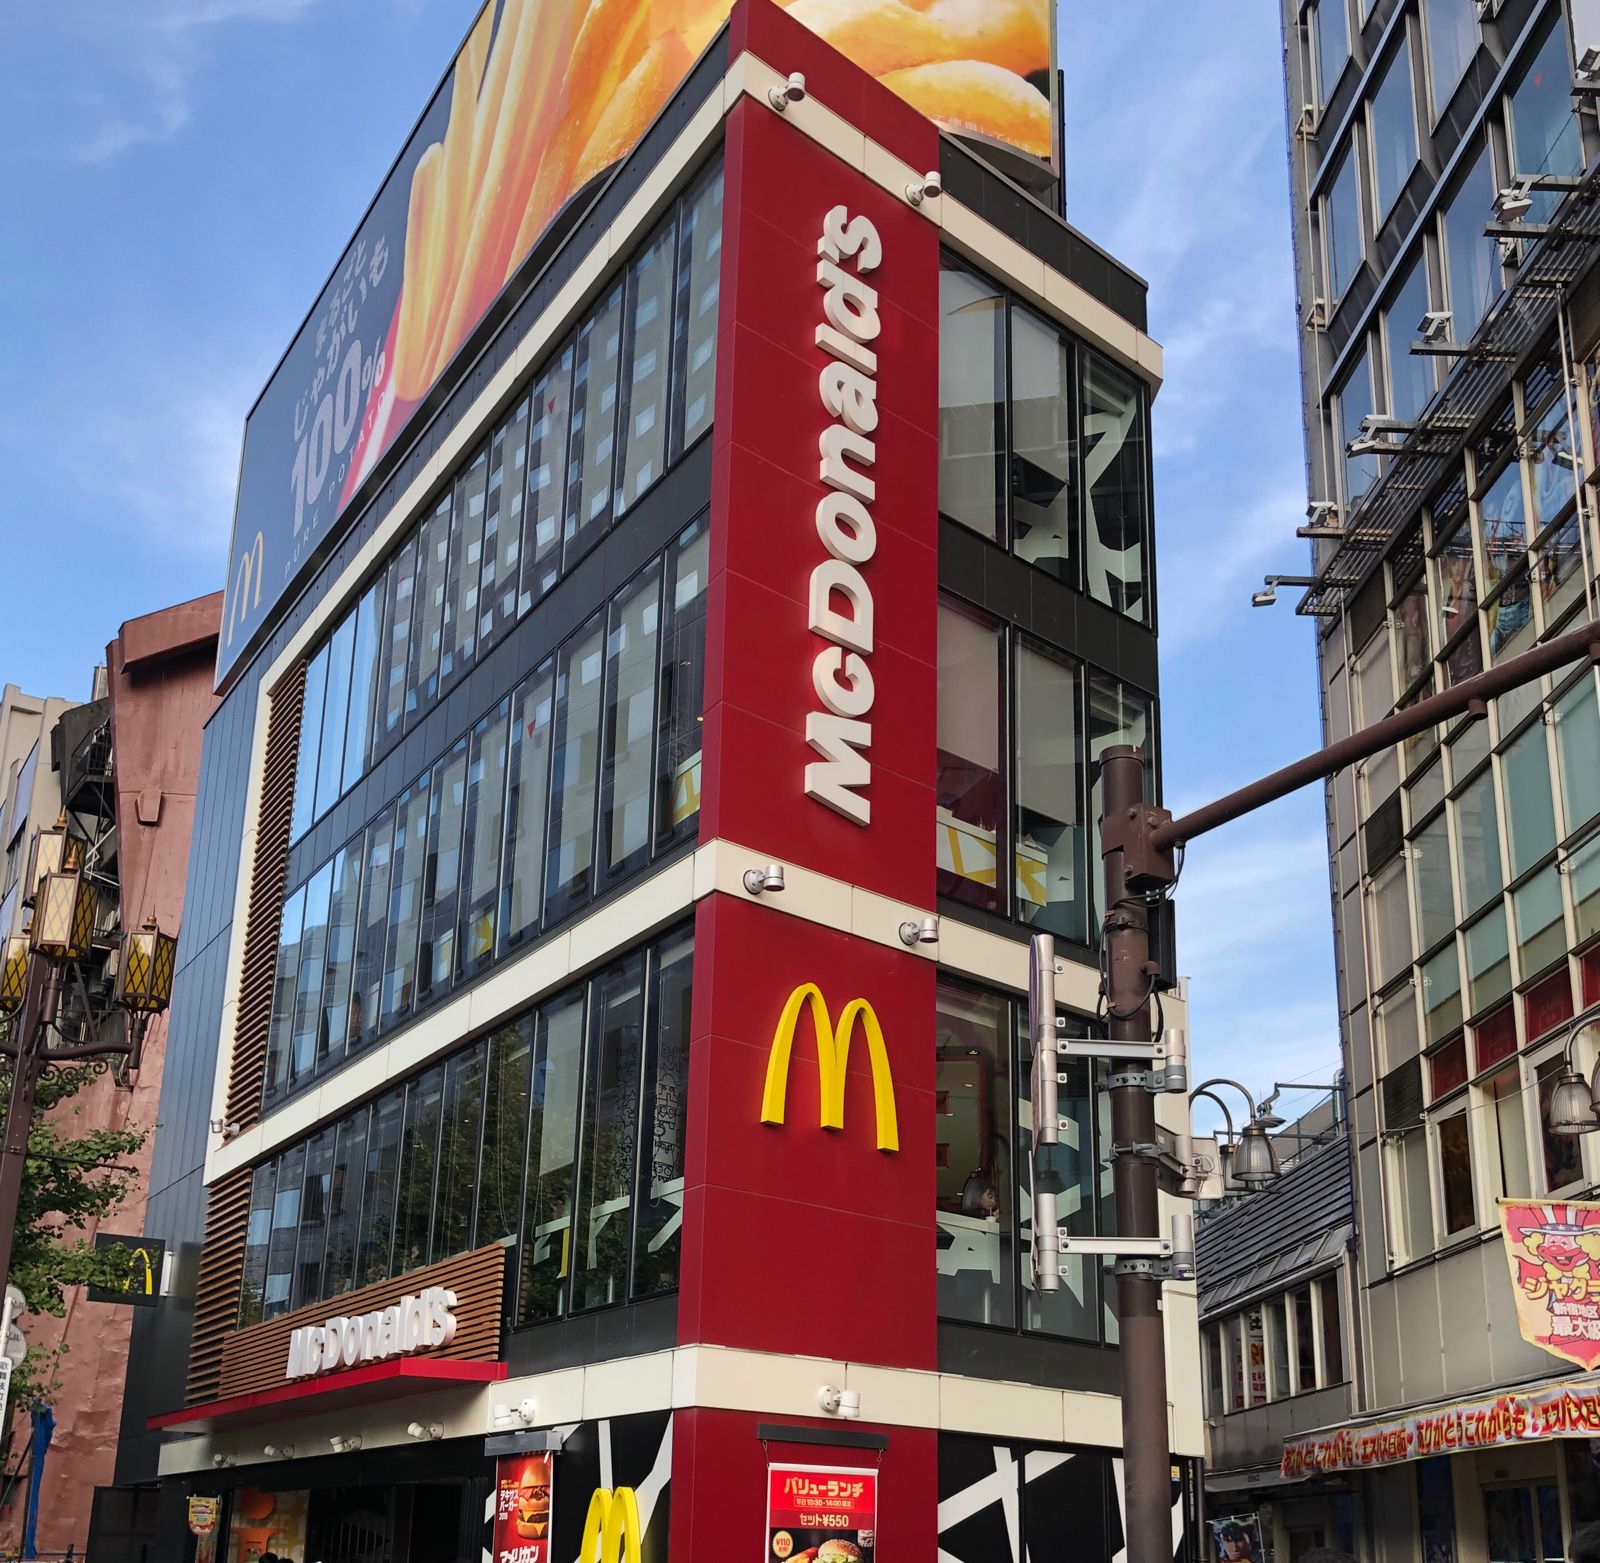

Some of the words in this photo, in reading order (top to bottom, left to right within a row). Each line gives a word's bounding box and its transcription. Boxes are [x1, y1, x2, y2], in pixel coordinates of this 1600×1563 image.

[293, 234, 389, 442] じゃがいも
[314, 239, 367, 358] まるごと
[291, 334, 386, 539] 100%
[284, 508, 319, 579] PURE
[804, 204, 883, 827] McDonald's
[285, 1286, 458, 1379] McDonald's
[499, 1501, 518, 1512] バーガー
[783, 1477, 864, 1498] バリューランチ
